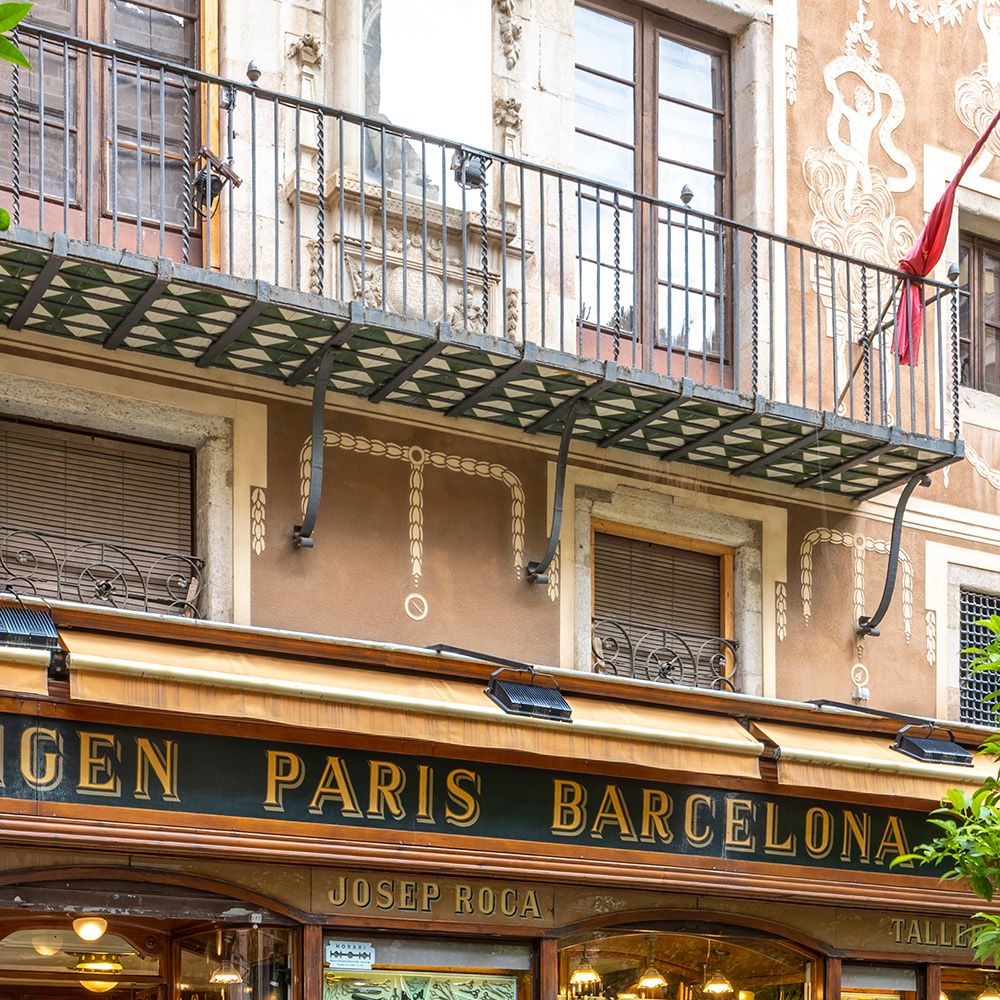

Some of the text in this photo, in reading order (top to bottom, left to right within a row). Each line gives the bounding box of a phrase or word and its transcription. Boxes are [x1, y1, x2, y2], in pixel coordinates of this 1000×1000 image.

[263, 750, 481, 828] PARIS
[551, 778, 914, 869] BARCELONA
[328, 877, 543, 919] JOSEP ROCA
